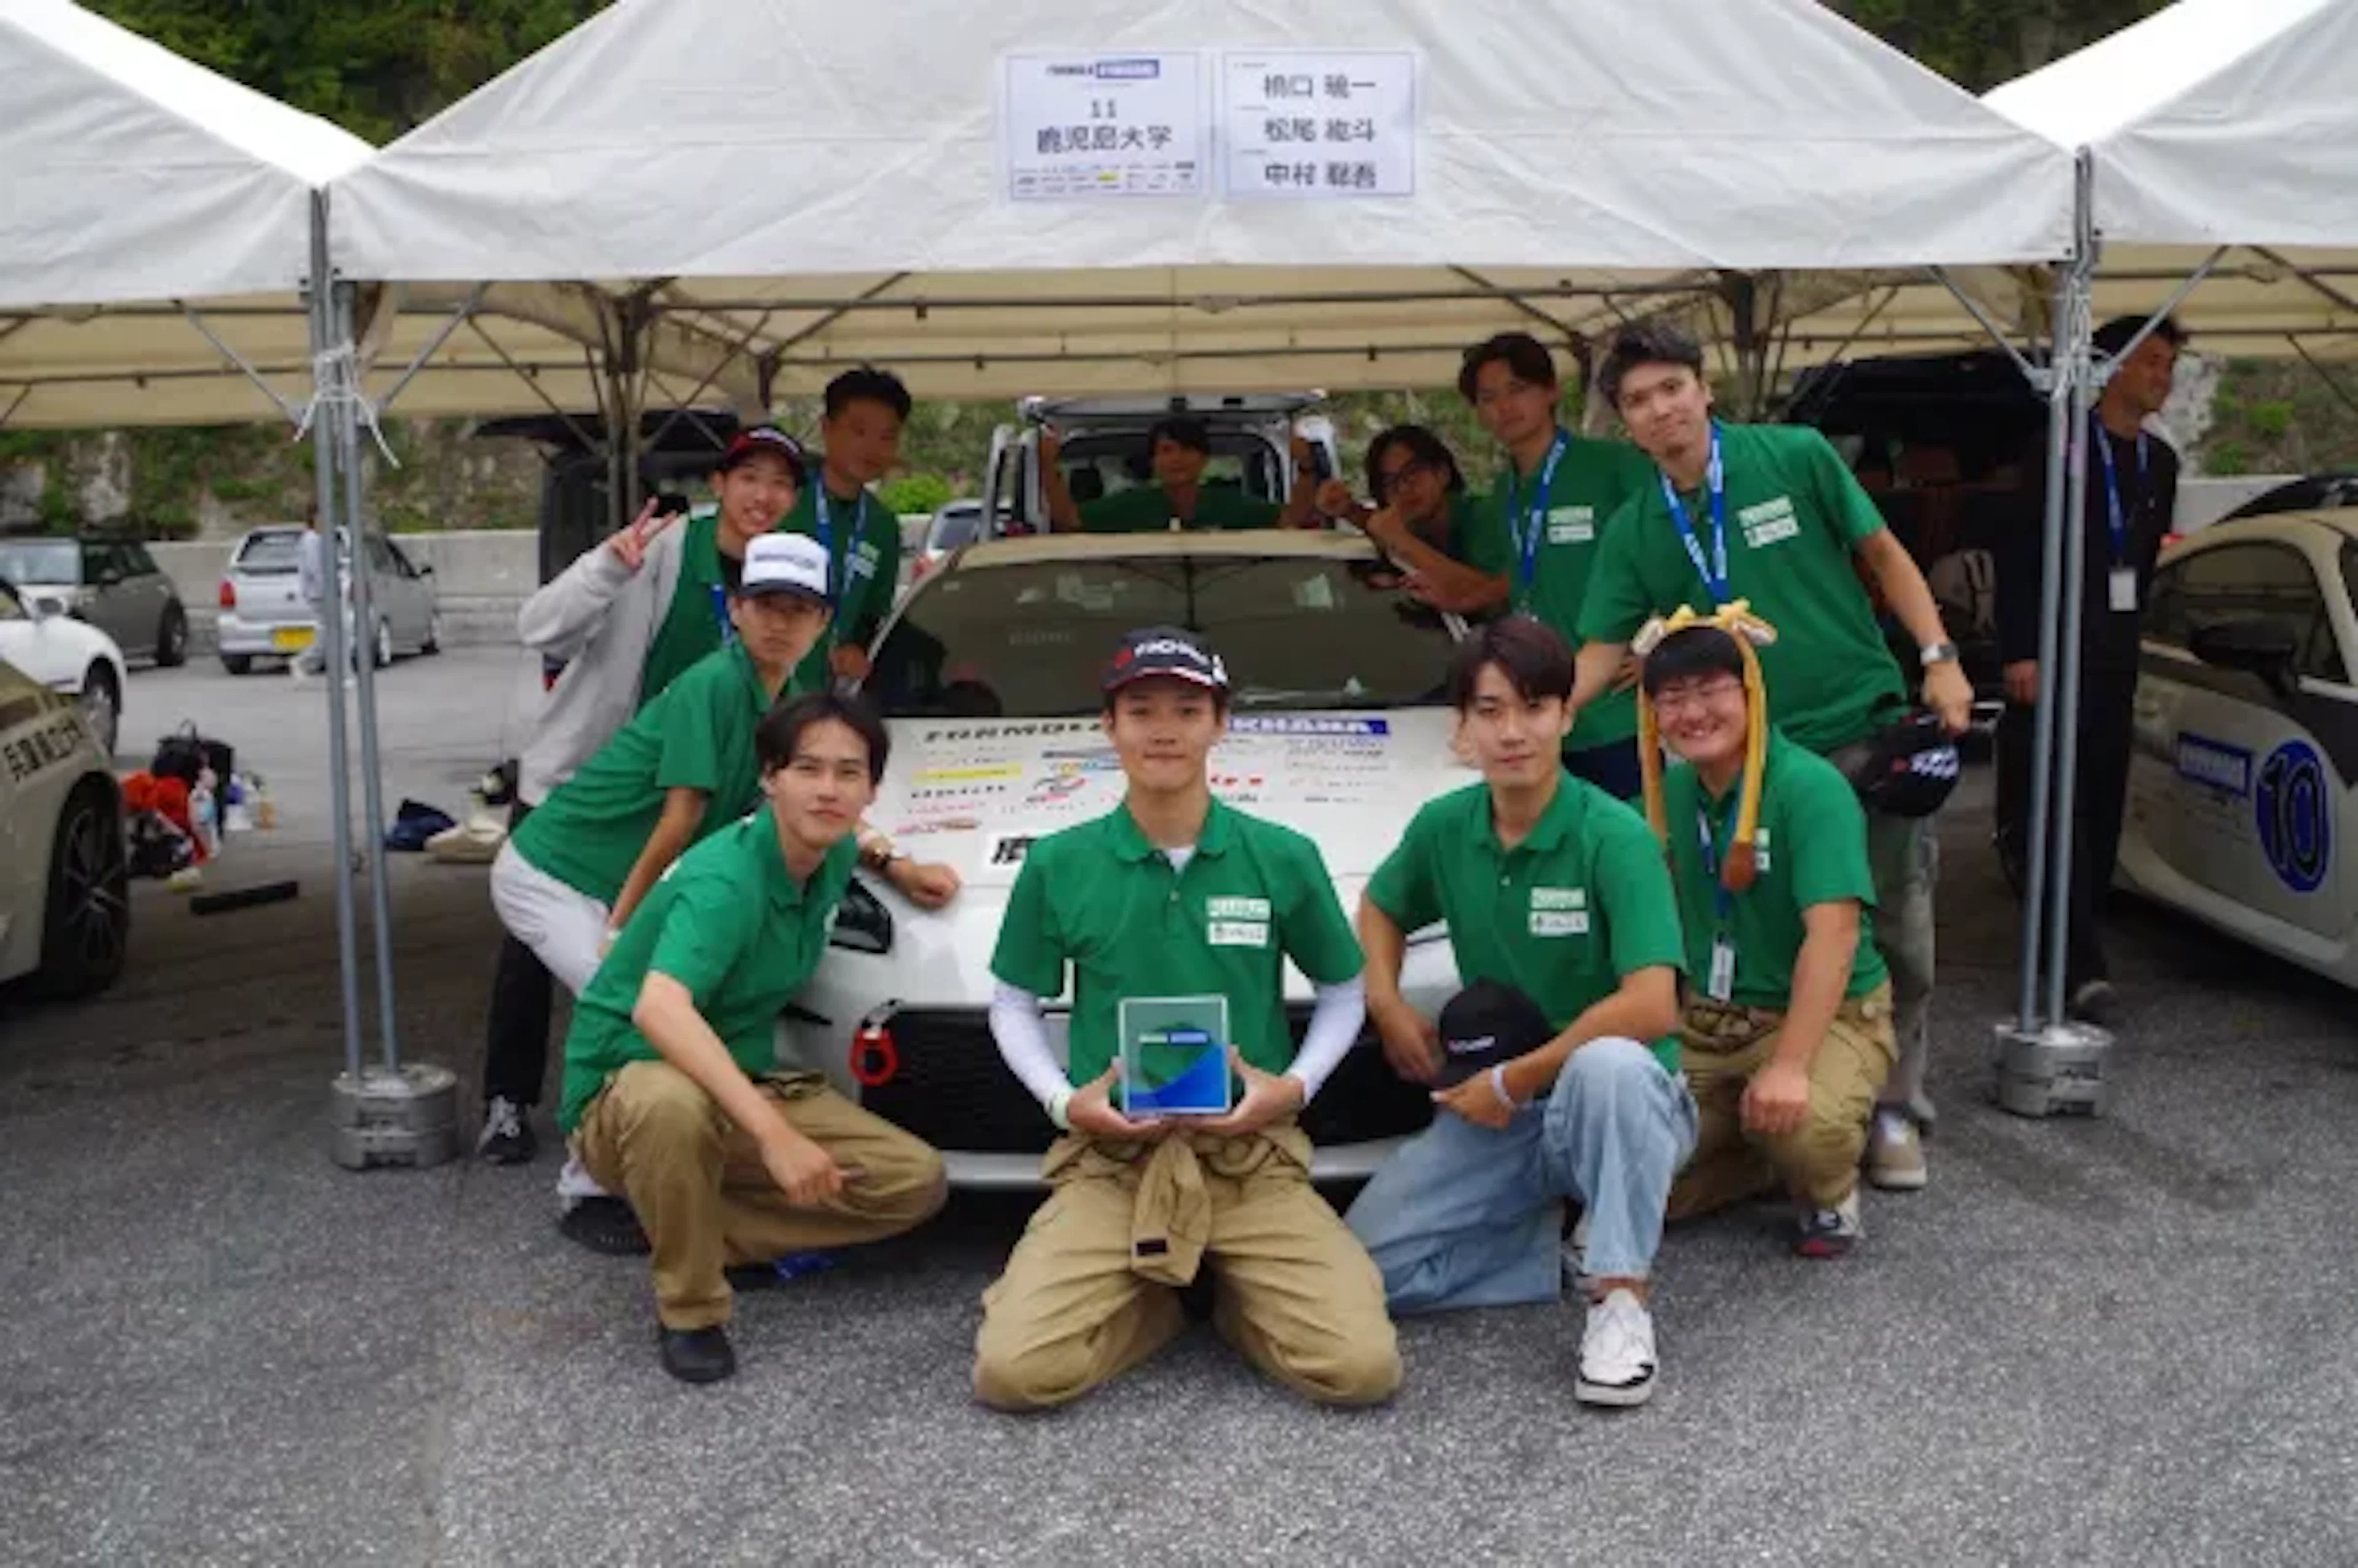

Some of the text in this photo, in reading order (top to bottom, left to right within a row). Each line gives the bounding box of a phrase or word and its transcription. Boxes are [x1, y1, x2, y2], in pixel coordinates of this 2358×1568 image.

[1038, 126, 1172, 153] 鹿児島大学
[1265, 162, 1317, 187] 中村
[2260, 753, 2325, 882] 10
